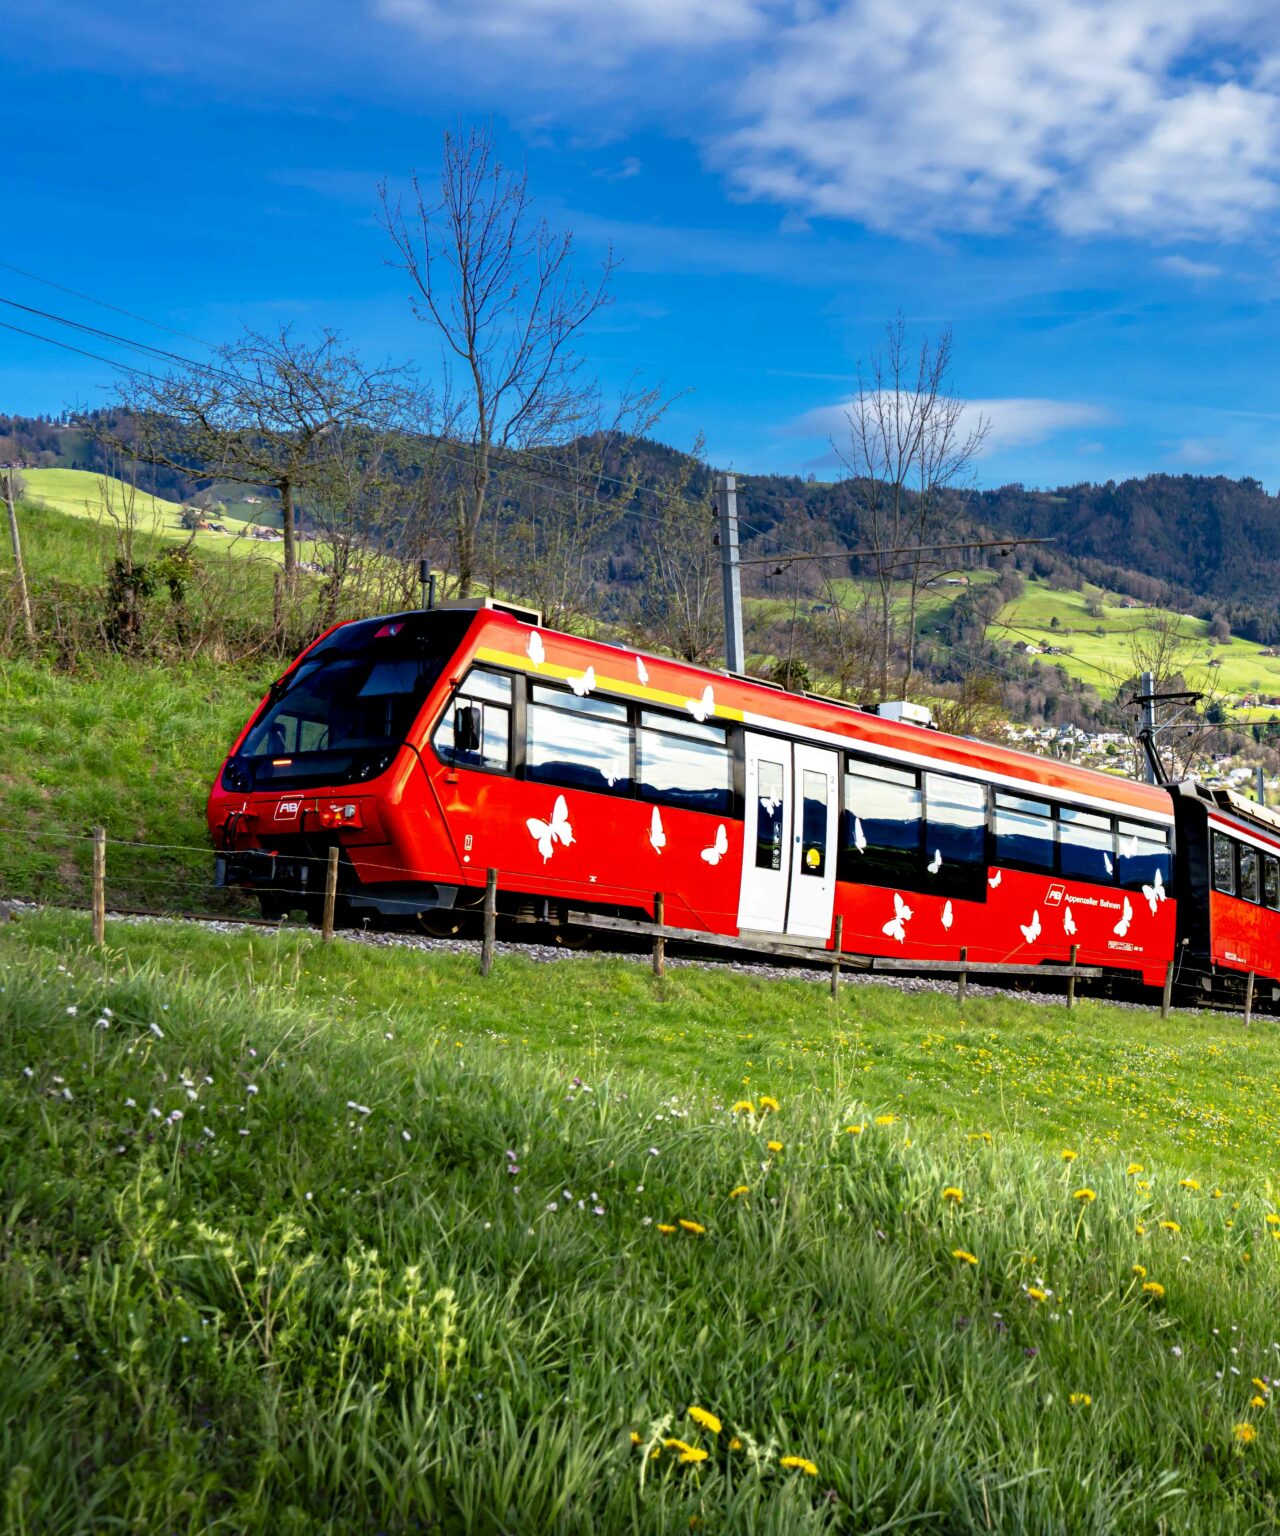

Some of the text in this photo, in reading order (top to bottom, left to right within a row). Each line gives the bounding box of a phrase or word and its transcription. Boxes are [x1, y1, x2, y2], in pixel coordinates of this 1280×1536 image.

[830, 776, 835, 784] 2
[279, 803, 298, 813] AB
[1049, 891, 1120, 909] AB Appenzeller Bahnen
